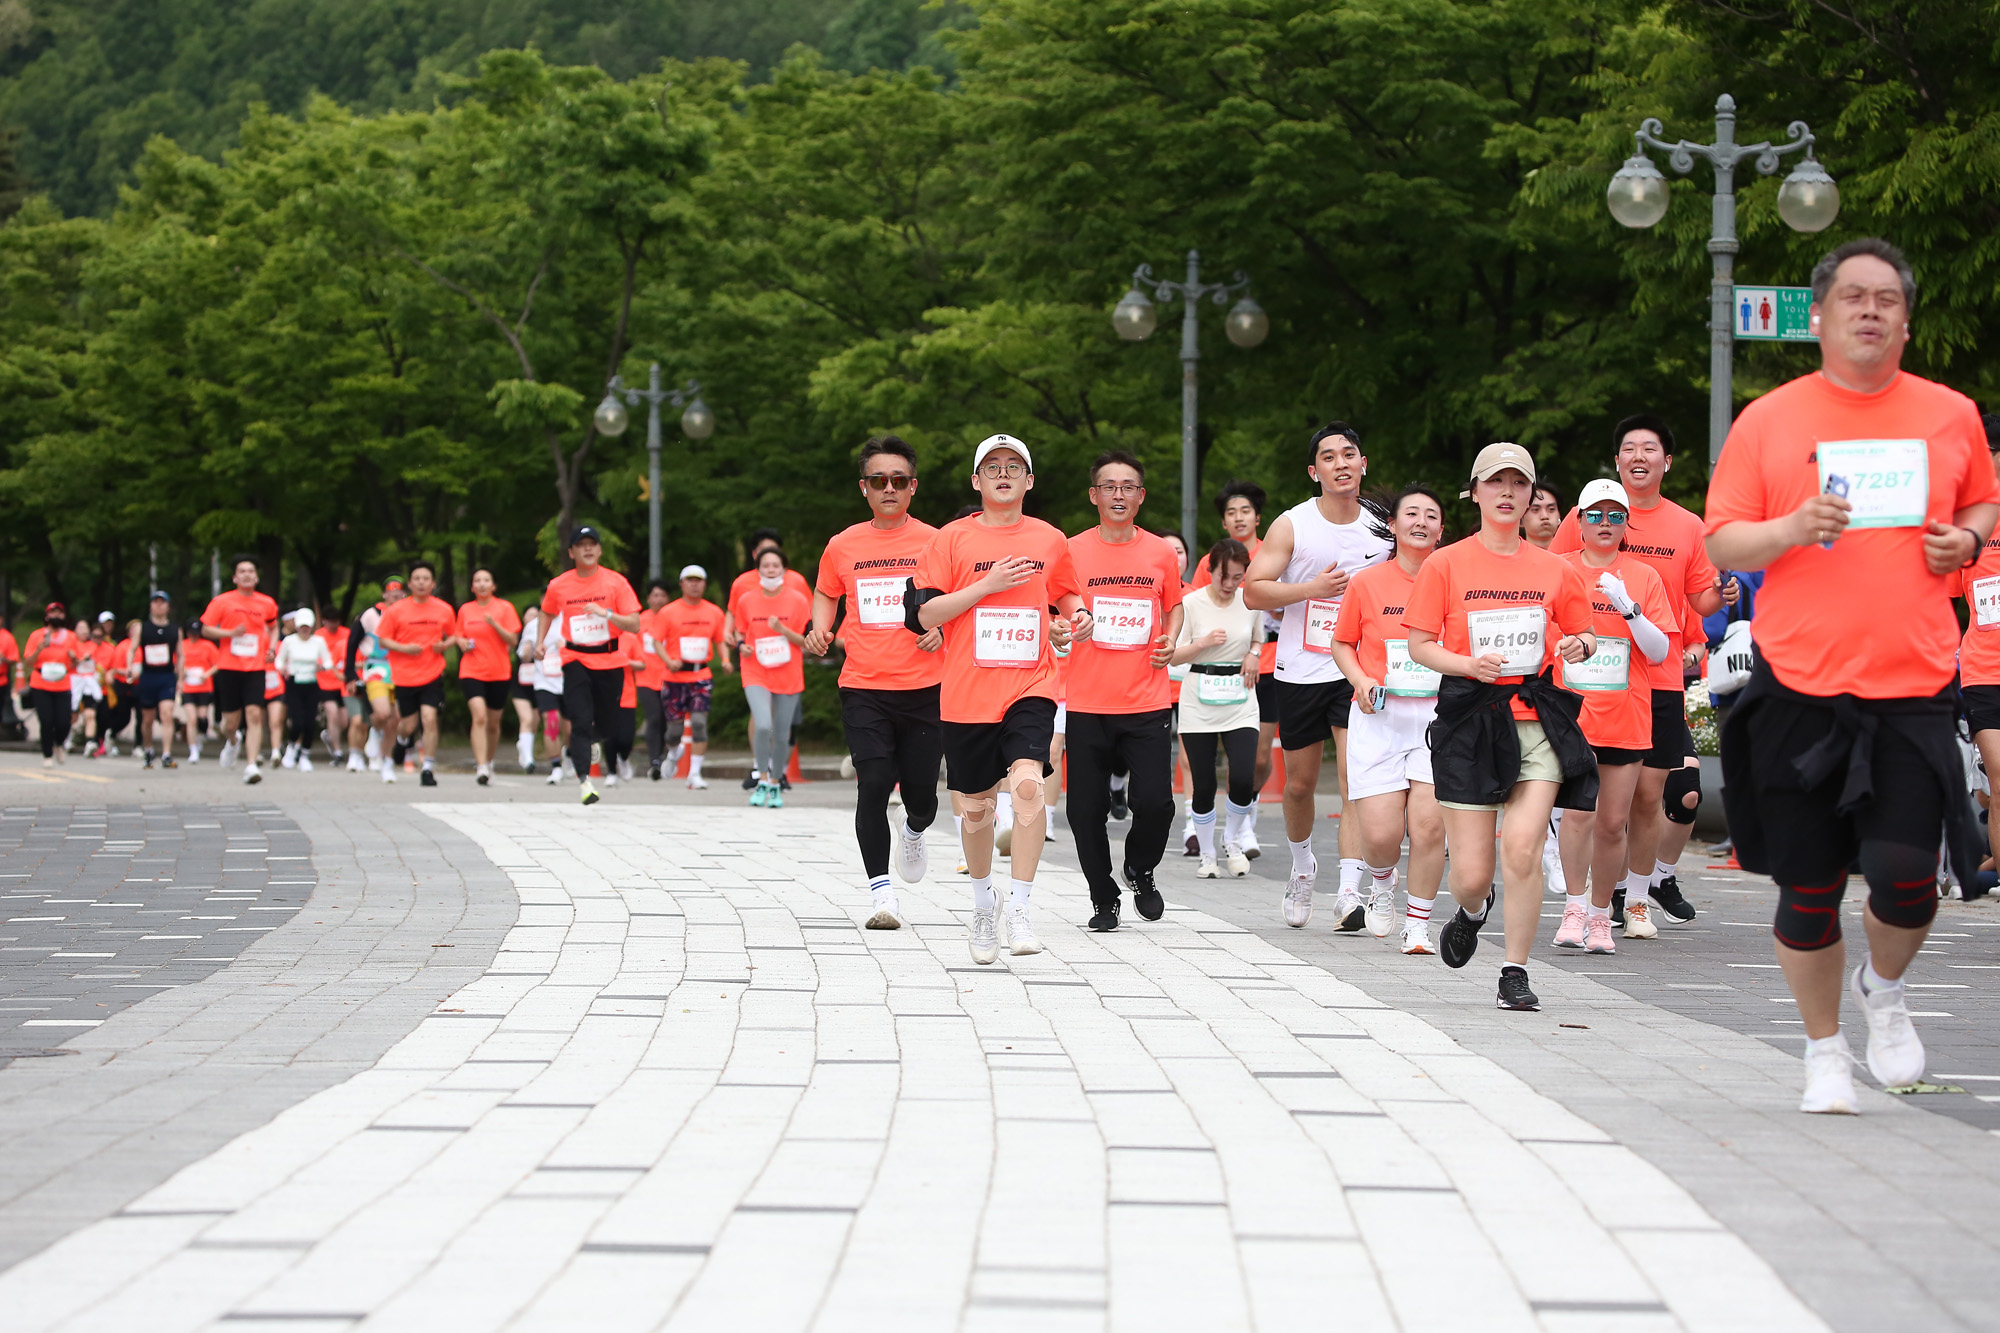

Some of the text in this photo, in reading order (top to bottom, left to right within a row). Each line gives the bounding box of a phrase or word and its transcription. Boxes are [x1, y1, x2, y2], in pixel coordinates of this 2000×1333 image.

[1854, 470, 1915, 490] 7287
[1654, 546, 1675, 556] RUN
[854, 559, 896, 570] BURNING
[1088, 576, 1154, 587] BURNING RUN
[1464, 590, 1545, 601] BURNING RUN
[1980, 598, 1987, 606] M
[1110, 615, 1145, 628] 1244
[1476, 615, 1504, 623] BURNING
[982, 628, 1035, 641] M 1163
[1479, 631, 1538, 647] W 6109
[1213, 678, 1241, 686] 8115
